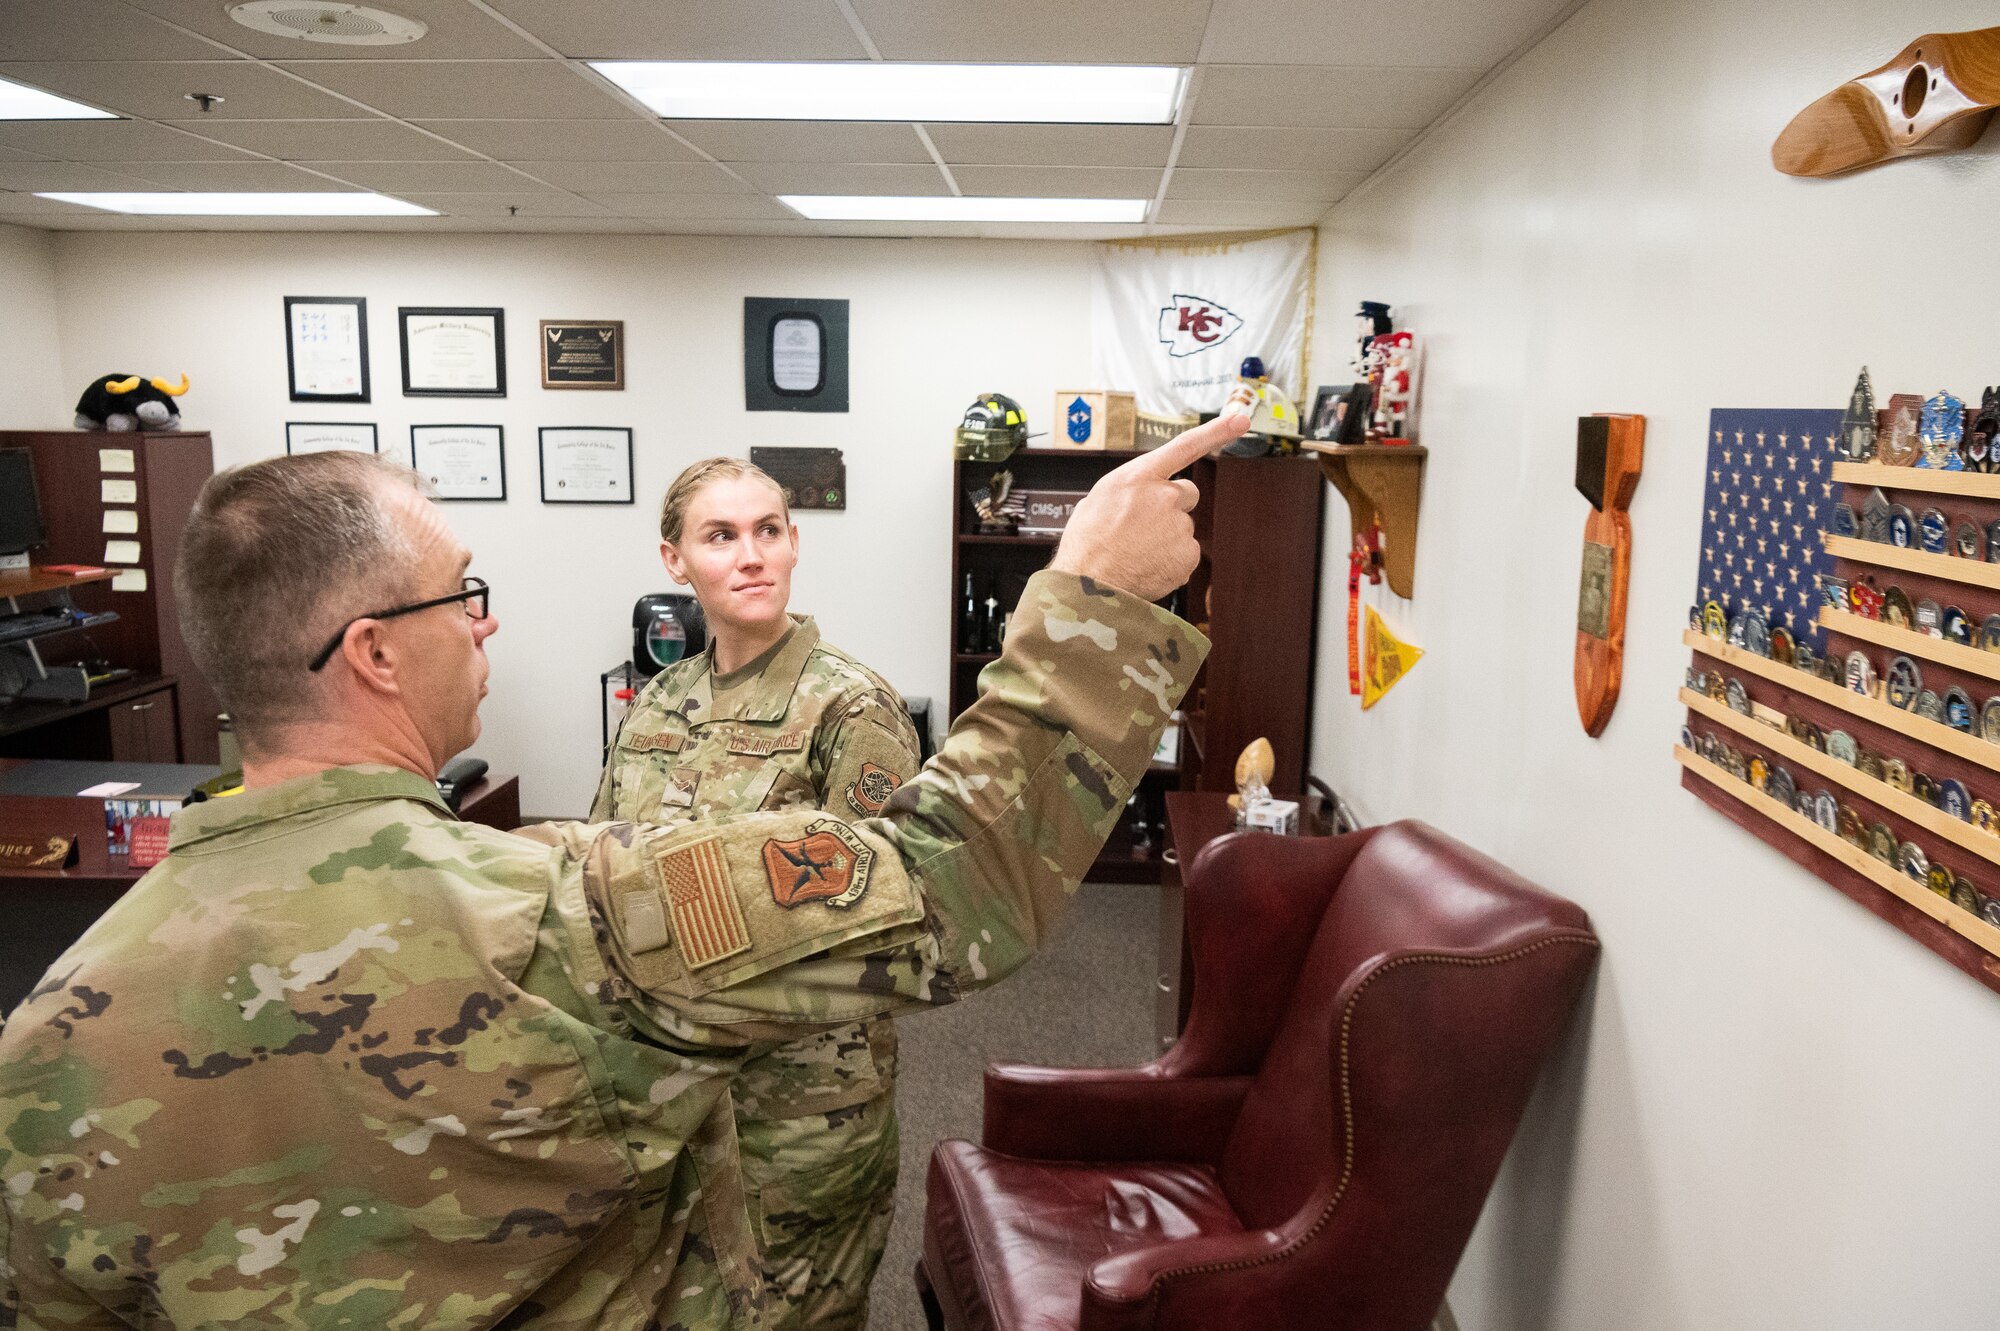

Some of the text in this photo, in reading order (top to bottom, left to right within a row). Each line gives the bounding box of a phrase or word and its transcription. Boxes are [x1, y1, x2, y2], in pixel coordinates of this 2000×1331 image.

[1178, 307, 1223, 343] KC
[1030, 503, 1063, 519] CMSgt
[752, 739, 771, 754] AIR
[830, 823, 854, 843] WING
